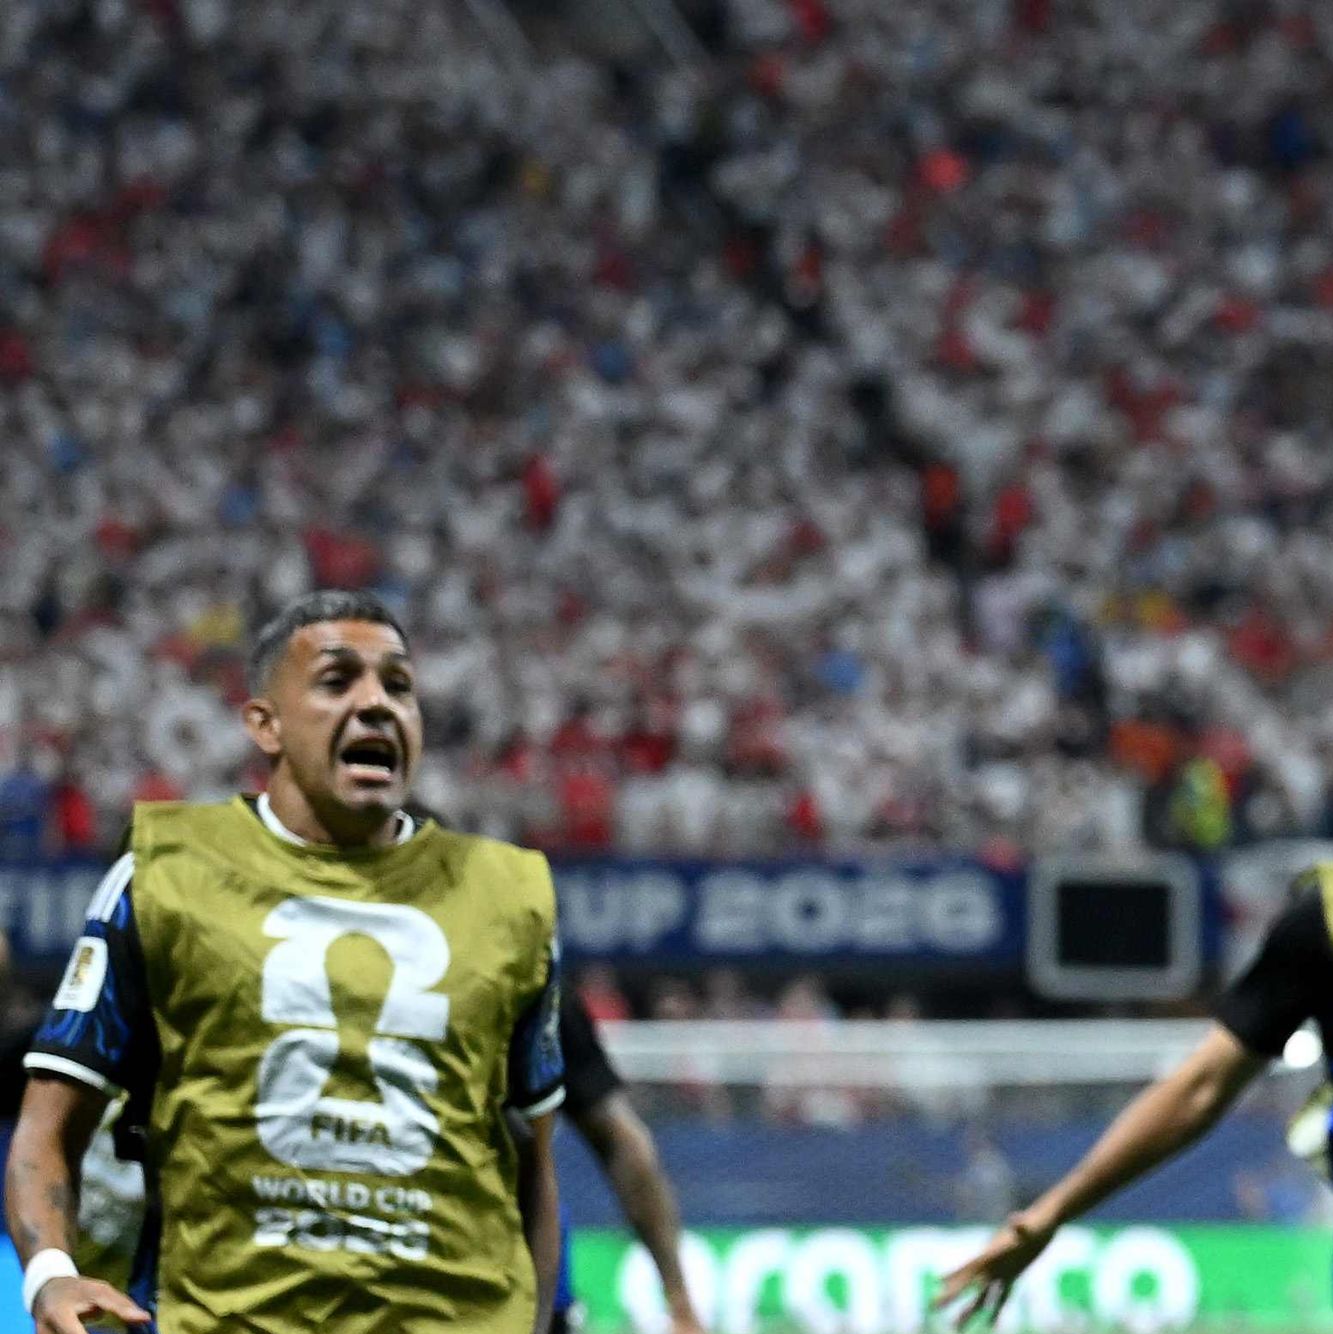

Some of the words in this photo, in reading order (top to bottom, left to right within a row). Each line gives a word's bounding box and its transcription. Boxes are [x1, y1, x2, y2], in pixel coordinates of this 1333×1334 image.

[562, 868, 685, 952] UP
[698, 866, 1001, 954] 2026
[311, 1112, 392, 1148] FIFA
[252, 1175, 371, 1209] WORLD
[375, 1186, 433, 1213] CUP
